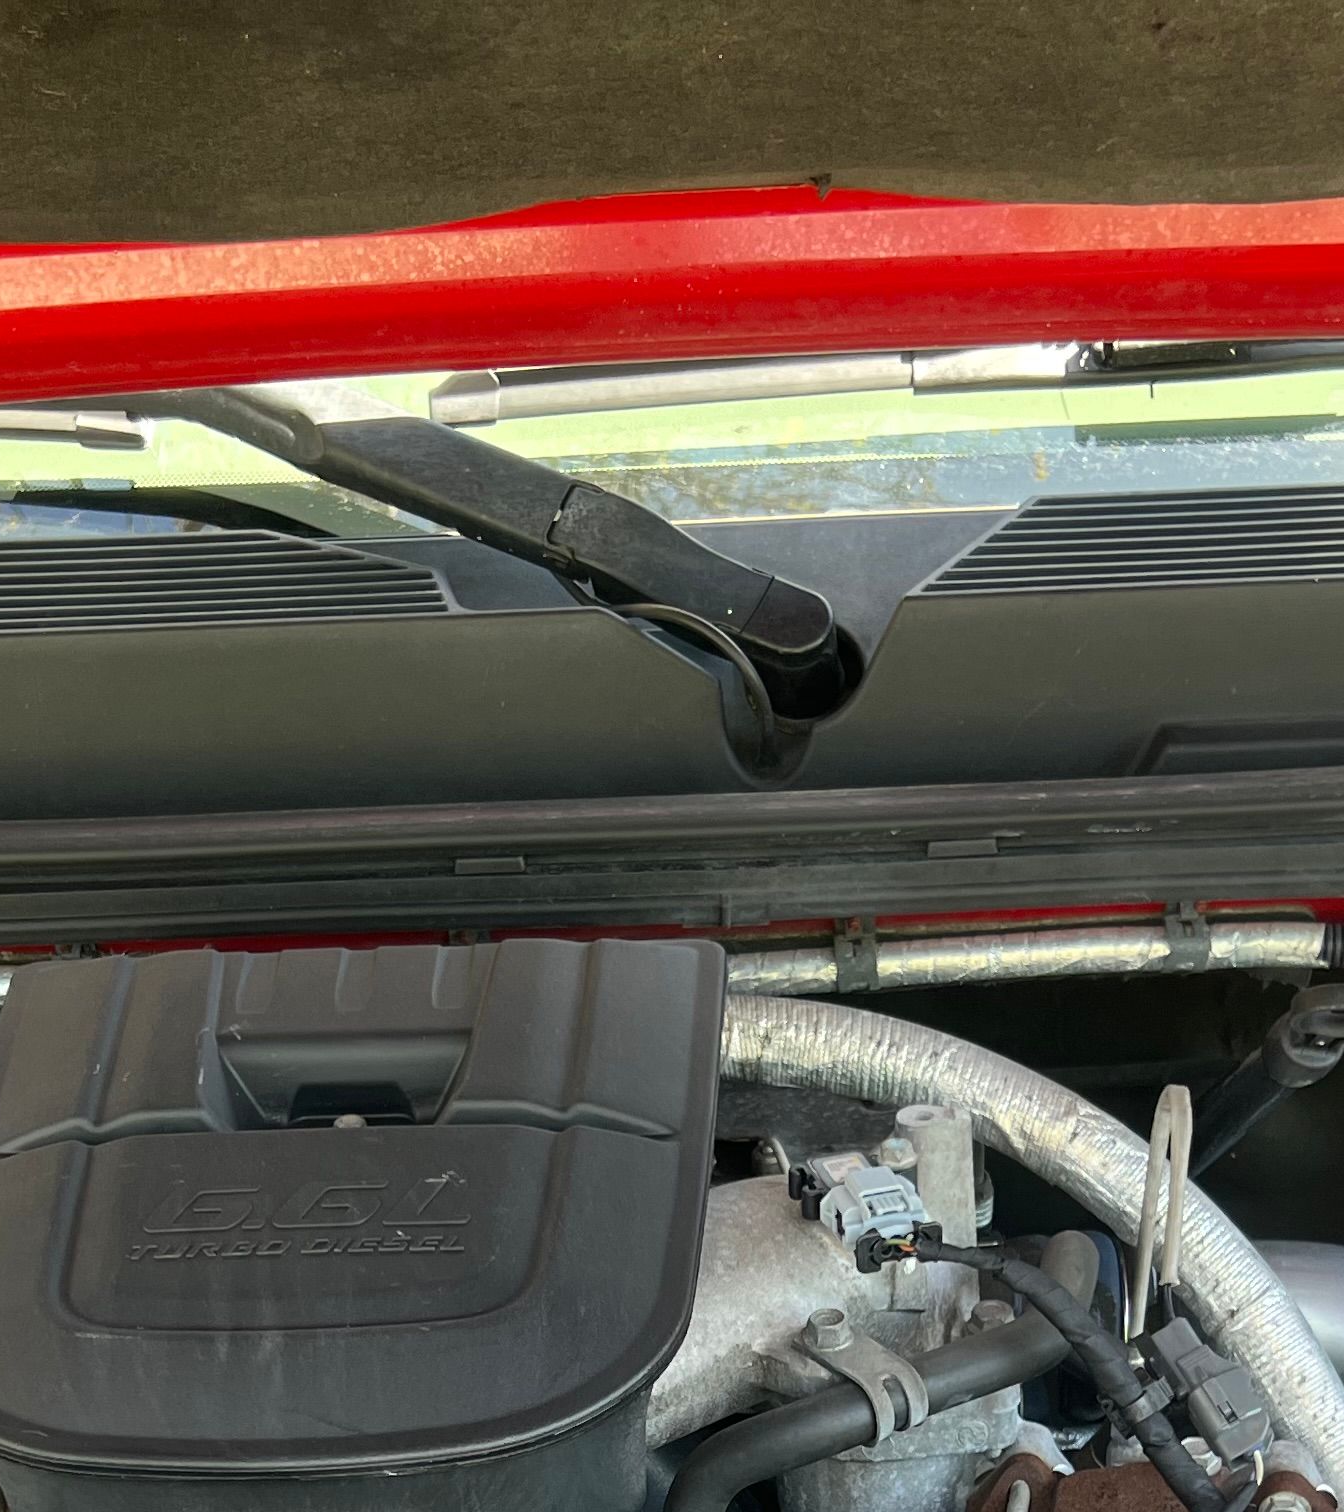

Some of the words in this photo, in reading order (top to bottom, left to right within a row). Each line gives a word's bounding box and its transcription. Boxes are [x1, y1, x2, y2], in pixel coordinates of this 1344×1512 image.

[142, 1177, 473, 1235] 6.6L
[126, 1240, 292, 1261] TURBO
[299, 1235, 466, 1255] DIESEL
